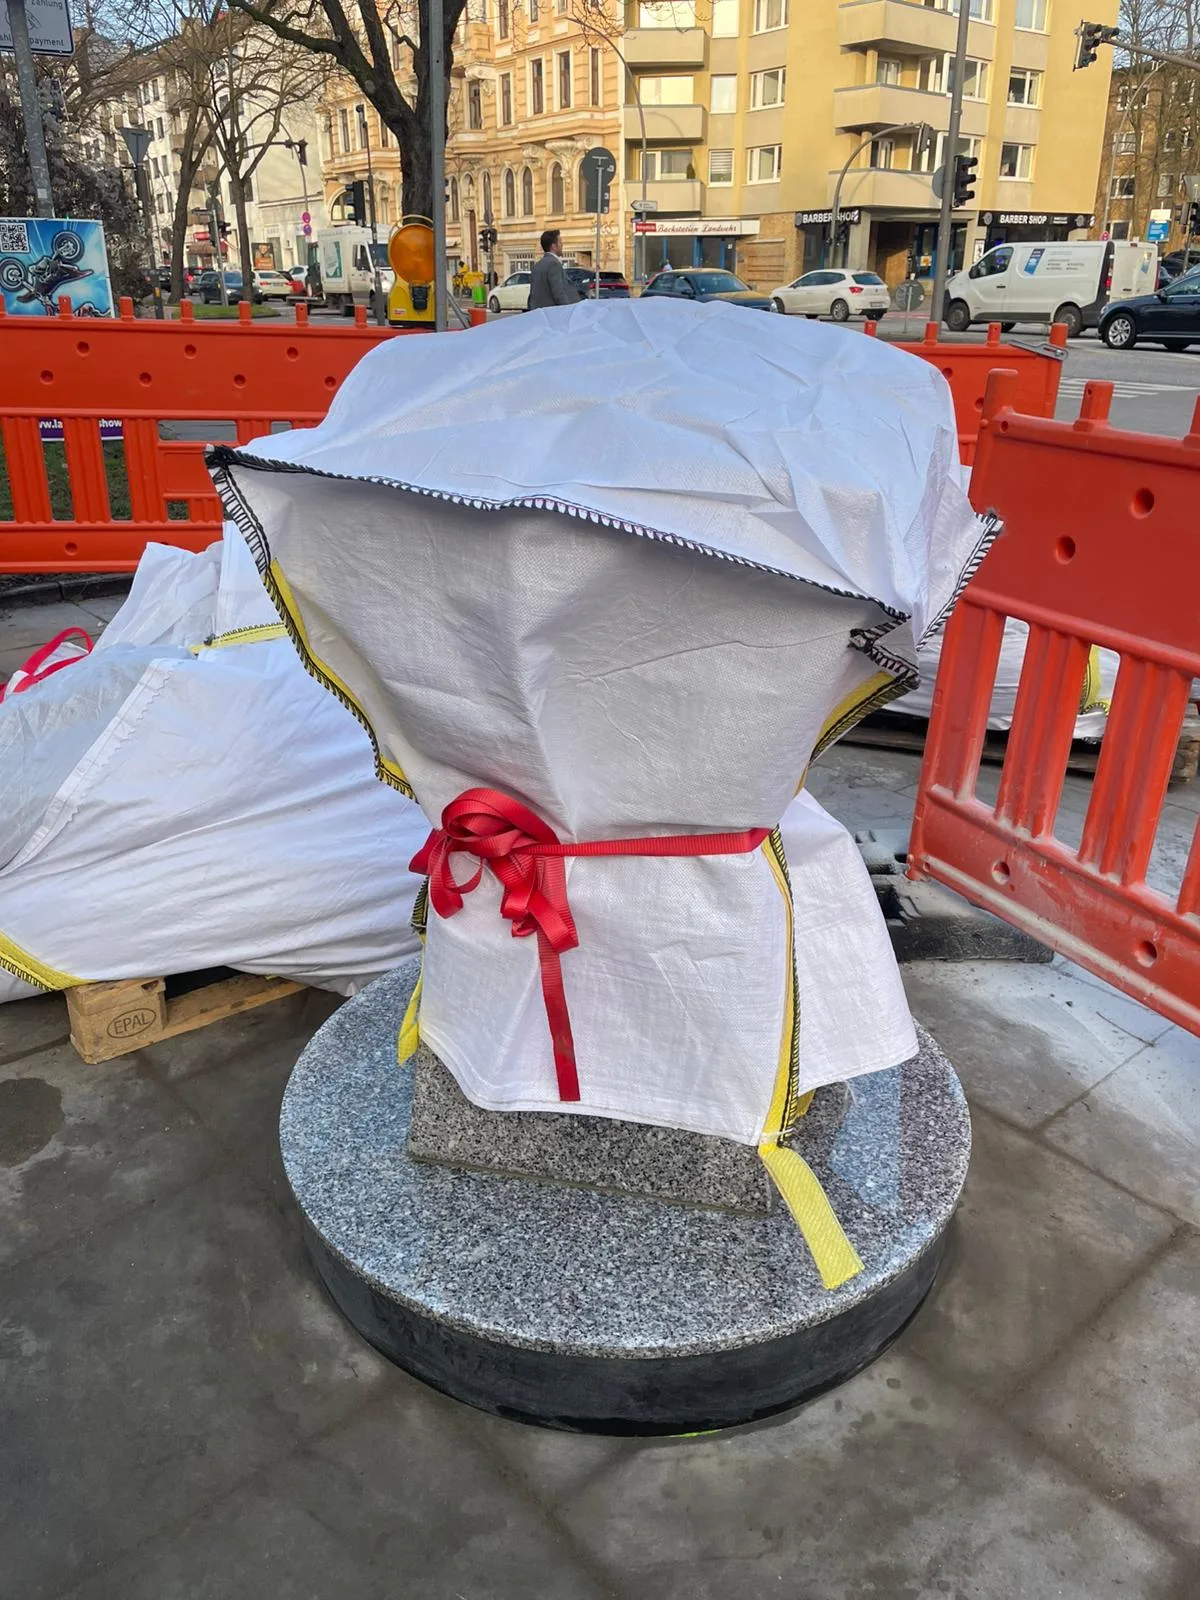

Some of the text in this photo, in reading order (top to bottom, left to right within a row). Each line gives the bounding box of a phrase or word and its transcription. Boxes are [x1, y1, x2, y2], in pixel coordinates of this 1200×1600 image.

[28, 37, 65, 47] payment
[802, 212, 833, 223] BARBER
[1000, 214, 1028, 224] BARBER
[1028, 214, 1047, 225] SHOP
[114, 1011, 151, 1035] EPAL
